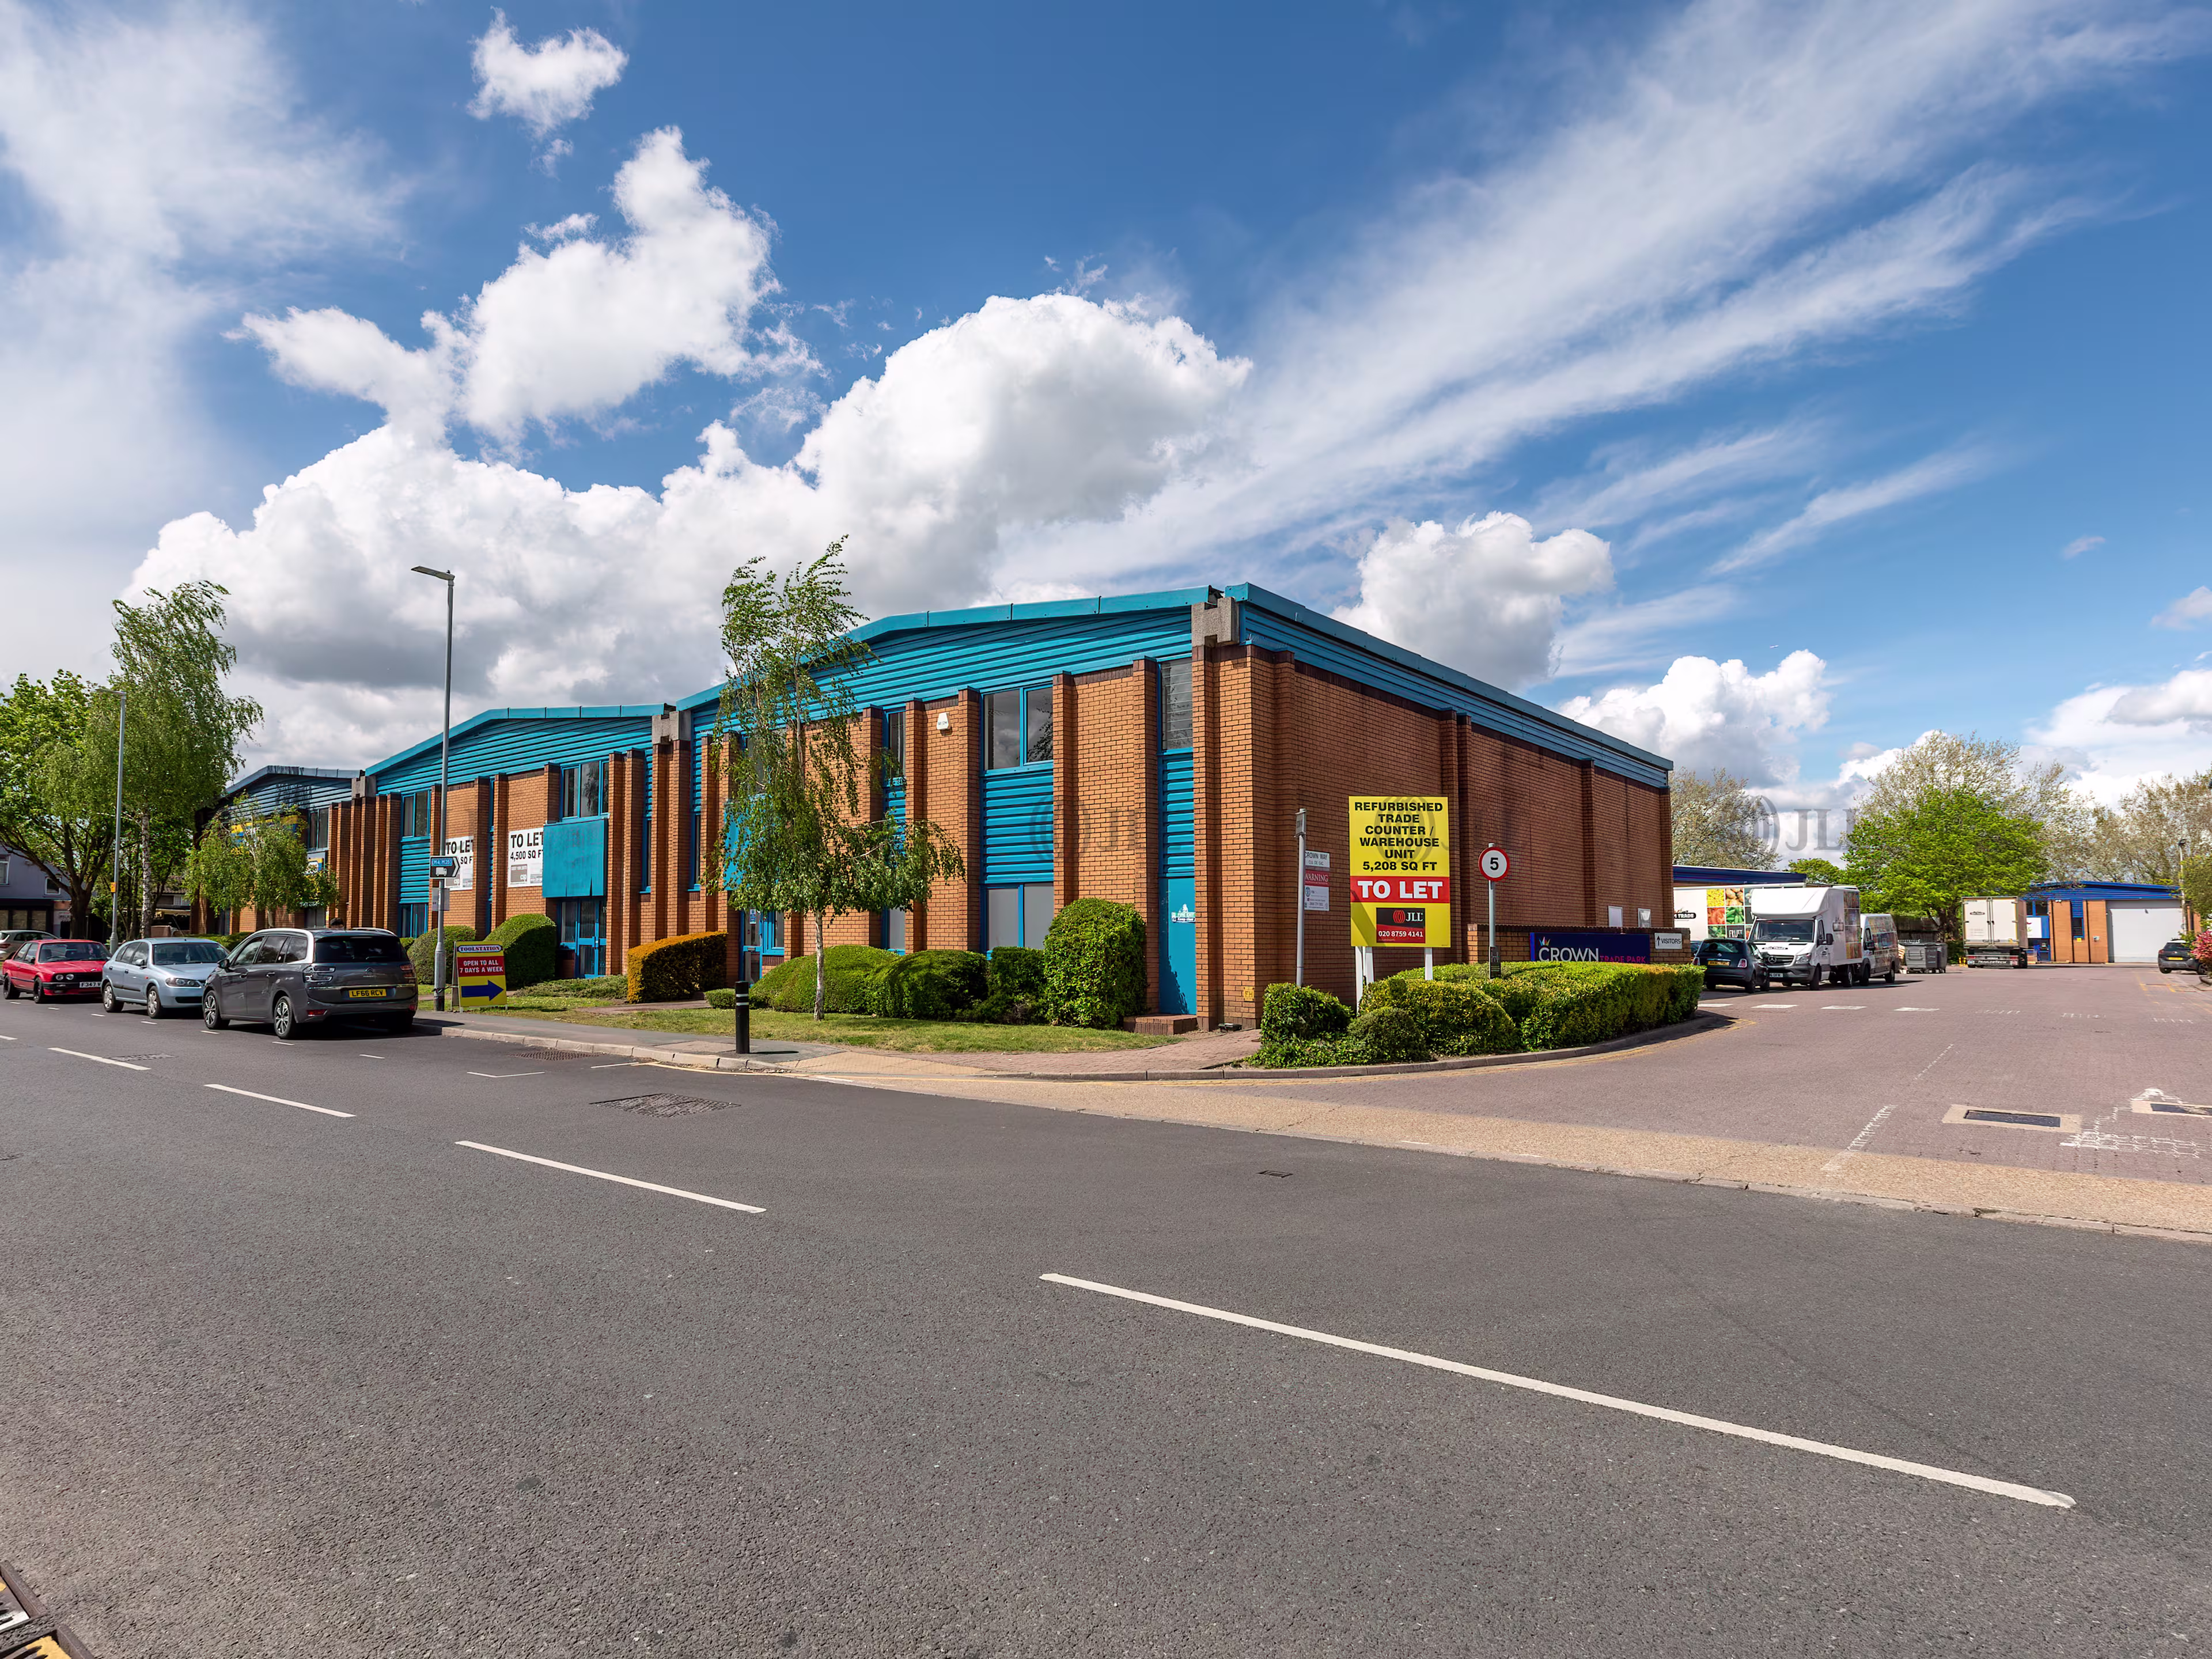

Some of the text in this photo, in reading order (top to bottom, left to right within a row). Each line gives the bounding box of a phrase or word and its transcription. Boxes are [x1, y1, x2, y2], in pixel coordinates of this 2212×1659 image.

[1355, 802, 1443, 812] REFURBISHED
[1378, 814, 1419, 823] TRADE
[1365, 825, 1434, 836] COUNTER /
[511, 834, 524, 849] TO
[1359, 837, 1440, 847] WAREHOUSE
[446, 841, 457, 854] TO
[510, 851, 526, 862] 4,500
[528, 850, 536, 858] SQ
[1385, 849, 1415, 859] UNIT
[460, 857, 468, 865] SQ
[1363, 861, 1437, 872] 5,208 SQ FT
[1490, 857, 1499, 870] 5
[1304, 873, 1328, 882] WARNING
[1357, 880, 1443, 899] TO LET
[1406, 912, 1423, 922] JLL
[1539, 947, 1599, 962] CROWN
